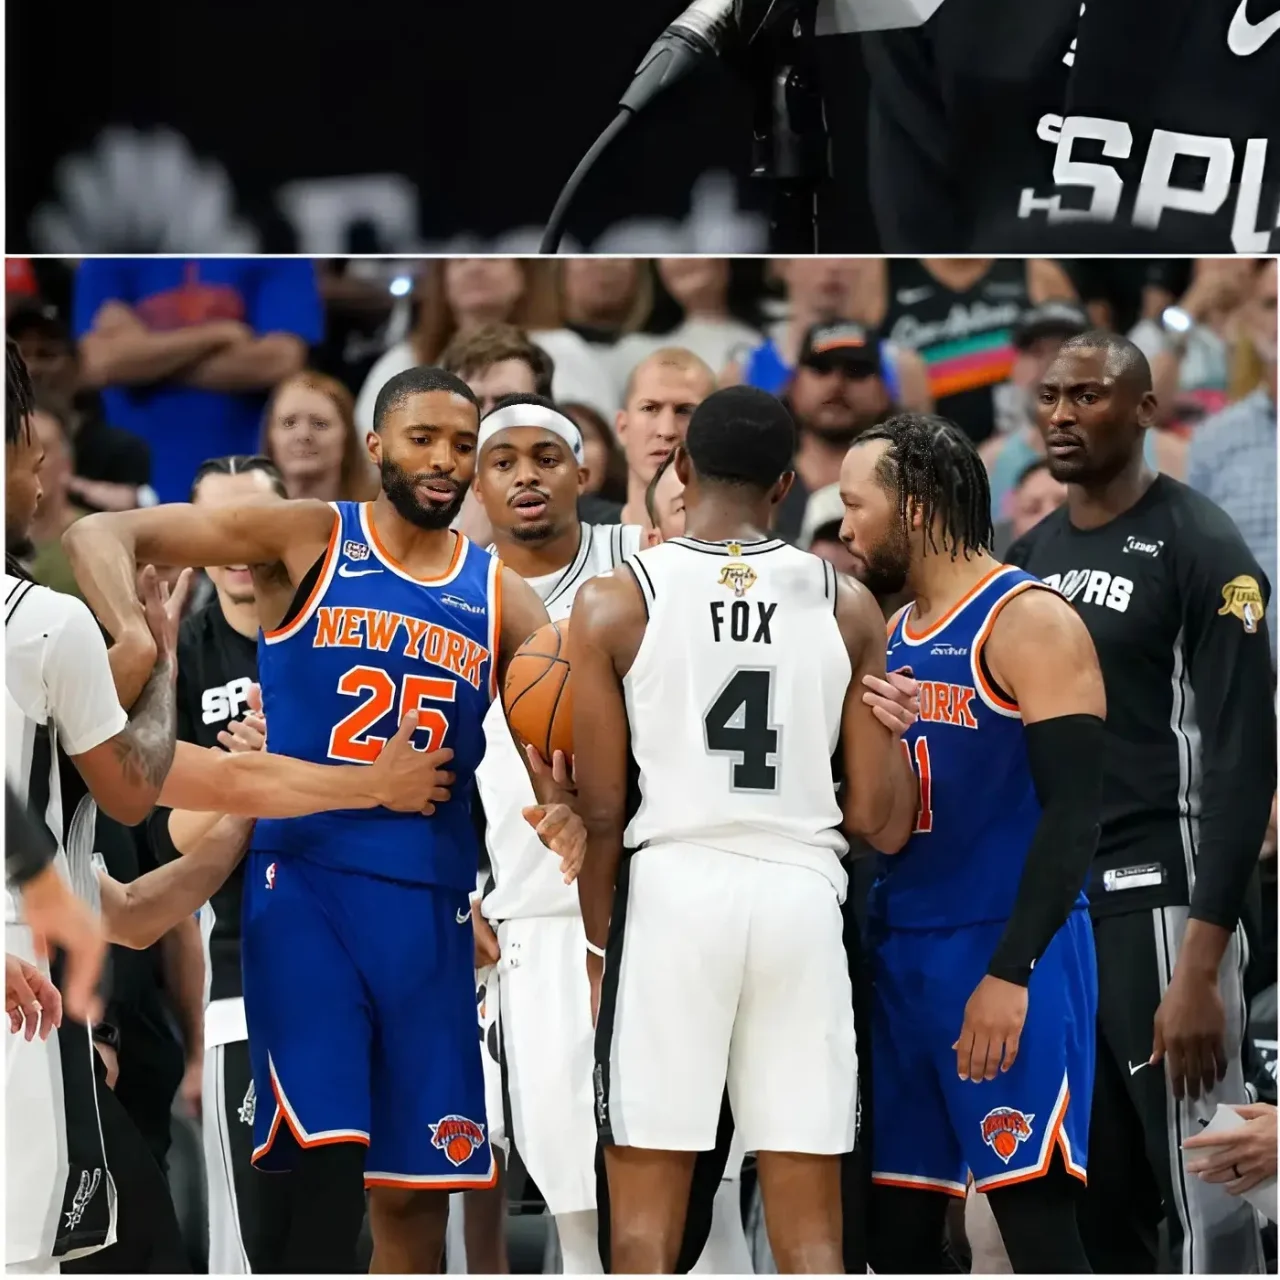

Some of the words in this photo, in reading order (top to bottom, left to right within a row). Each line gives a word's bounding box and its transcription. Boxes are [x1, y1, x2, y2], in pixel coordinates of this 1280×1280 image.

[313, 606, 402, 653] NEW
[402, 616, 492, 691] YORK
[709, 600, 778, 645] FOX
[327, 664, 457, 765] 25
[701, 664, 784, 795] 4
[915, 680, 979, 730] ORK
[900, 735, 933, 833] 1
